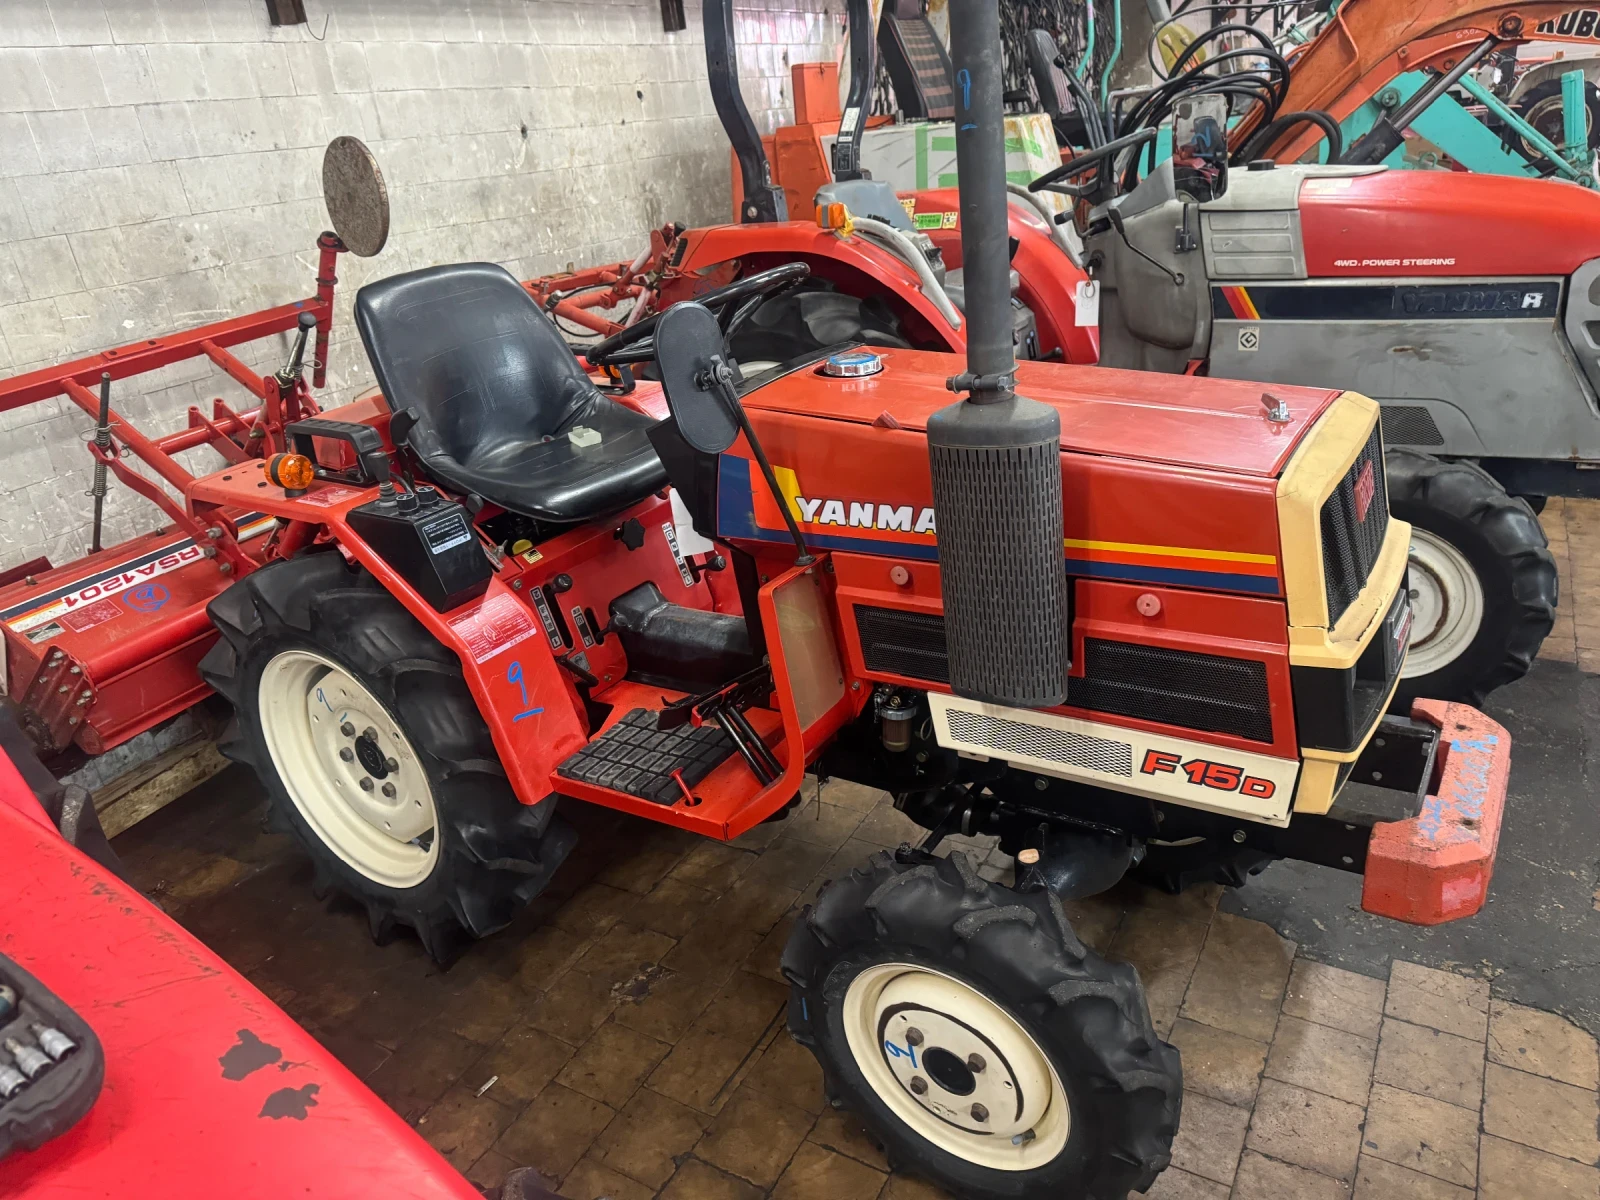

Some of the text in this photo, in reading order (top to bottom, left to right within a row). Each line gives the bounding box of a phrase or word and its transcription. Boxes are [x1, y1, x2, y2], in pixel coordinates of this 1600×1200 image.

[957, 68, 972, 111] 9
[1362, 258, 1400, 267] POWER
[1402, 257, 1456, 266] STEERING
[61, 547, 199, 607] RSA1201
[316, 687, 334, 712] 9
[507, 661, 528, 705] 9
